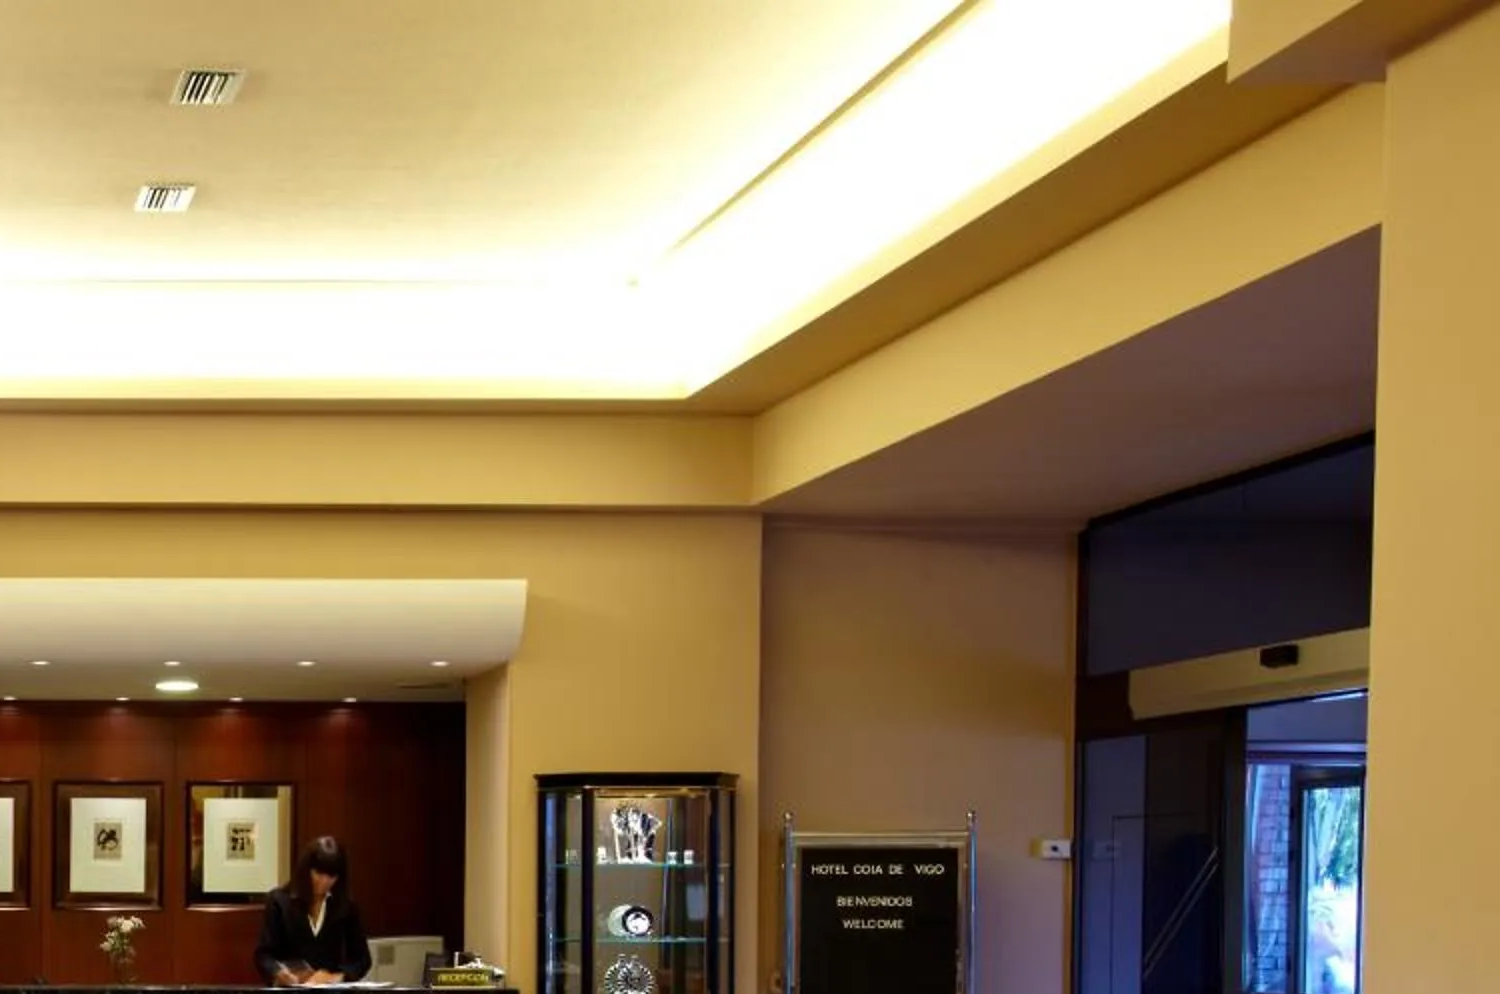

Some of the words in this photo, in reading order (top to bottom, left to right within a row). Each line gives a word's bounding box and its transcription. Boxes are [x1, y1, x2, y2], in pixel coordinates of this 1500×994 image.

[811, 864, 848, 875] HOTEL
[853, 864, 883, 875] COIA
[889, 864, 904, 875] DE
[914, 864, 945, 875] VIGO
[836, 896, 913, 907] BIENVENIDOS
[843, 919, 904, 929] WELCOME
